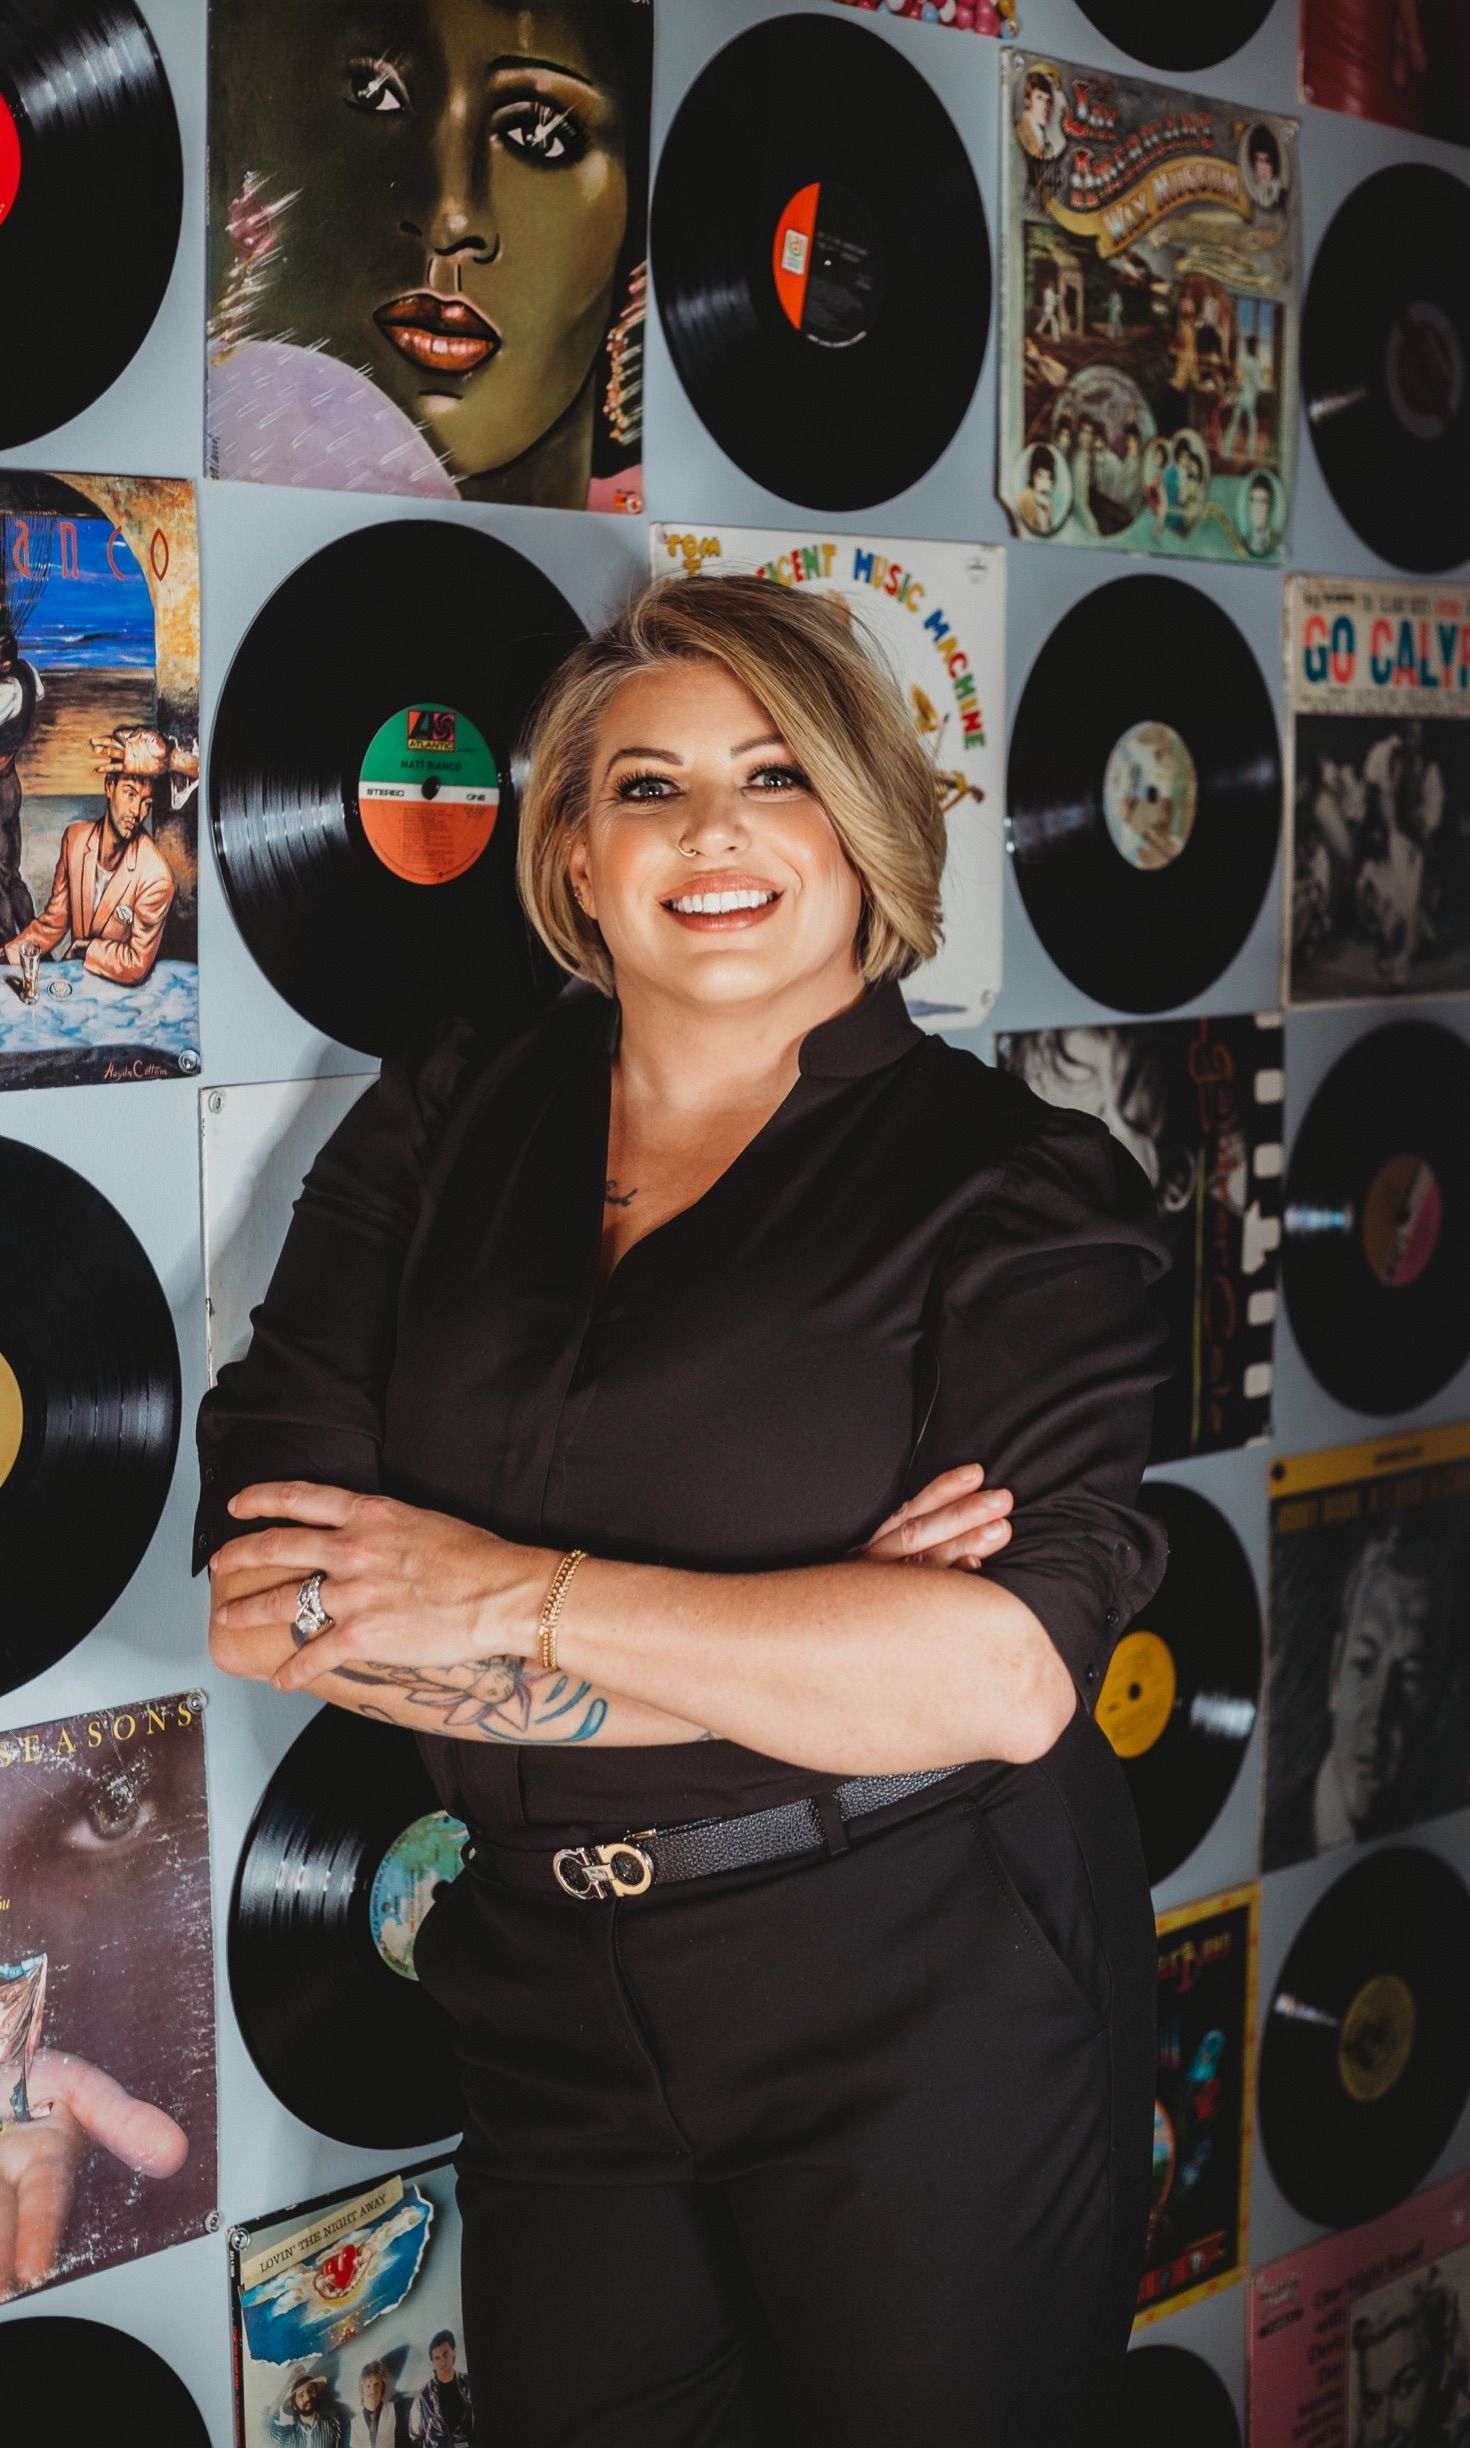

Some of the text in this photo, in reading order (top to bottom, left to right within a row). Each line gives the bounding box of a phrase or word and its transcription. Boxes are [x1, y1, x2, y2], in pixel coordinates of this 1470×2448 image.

[666, 533, 721, 559] TOM
[853, 547, 926, 613] MUSIC
[922, 608, 987, 750] MACHINE
[1304, 615, 1357, 687] GO
[408, 738, 454, 750] ATLANTIC
[401, 759, 462, 772] MATT BIANCO
[366, 787, 487, 801] STEREO ONE
[259, 2244, 297, 2273] LOVIN'
[298, 2230, 322, 2249] THE
[323, 2211, 358, 2237] NIGHT
[359, 2193, 387, 2218] AWAY
